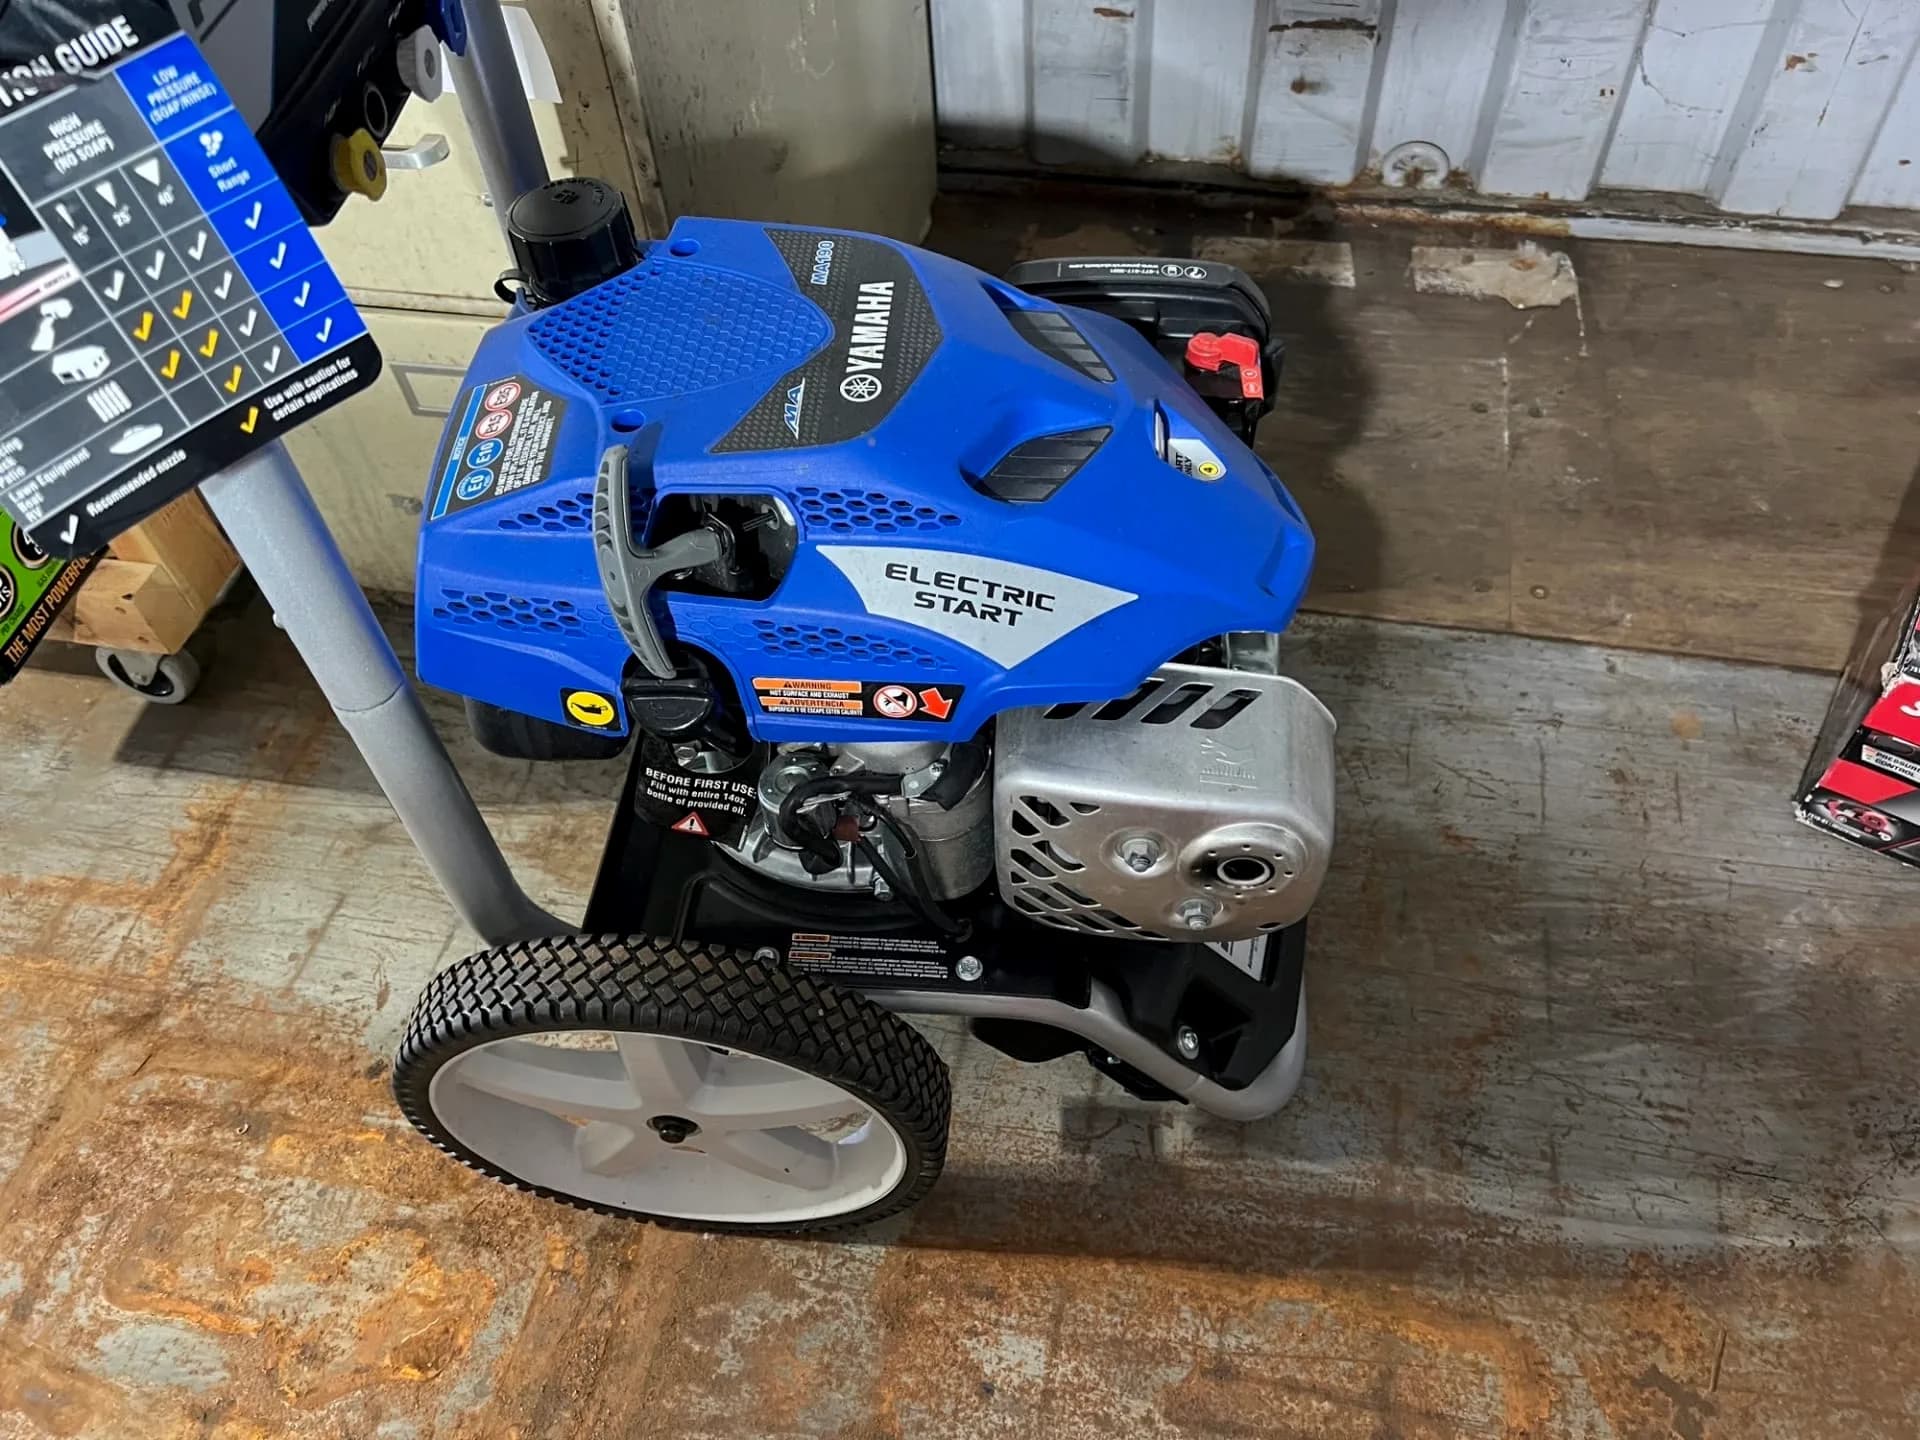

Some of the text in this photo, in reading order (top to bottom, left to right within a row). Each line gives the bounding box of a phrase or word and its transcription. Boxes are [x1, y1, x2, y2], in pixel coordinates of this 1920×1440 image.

[54, 15, 140, 75] GUIDE
[147, 72, 202, 107] PRESSURE
[152, 65, 179, 87] LOW
[43, 119, 106, 159] PRESSURE
[48, 112, 82, 138] HIGH
[53, 135, 114, 174] (NO SOAP)
[208, 157, 237, 179] Short
[217, 170, 251, 192] Range
[810, 240, 835, 286] MA190
[846, 281, 895, 373] YAMAHA
[264, 356, 351, 409] Use with caution for
[272, 368, 359, 421] certain applications
[784, 377, 806, 440] MA
[476, 441, 495, 465] E10
[8, 447, 91, 503] Lawn Equipment
[86, 449, 188, 517] Recommended nozzle
[467, 474, 485, 493] E0
[885, 562, 1056, 613] ELECTRIC
[914, 591, 1023, 627] START
[4, 636, 29, 664] THE
[22, 604, 49, 642] MOST
[769, 689, 781, 697] HOT
[823, 691, 849, 699] EXHAUST
[790, 699, 844, 708] ADVERTENCIA
[792, 682, 832, 690] WARNING
[645, 767, 757, 800] BEFORE FIRST USE:
[1875, 758, 1914, 777] CONTROL
[646, 788, 747, 817] bottle of provided oil.
[650, 780, 666, 791] Fill
[668, 786, 689, 796] with
[691, 790, 720, 800] entire
